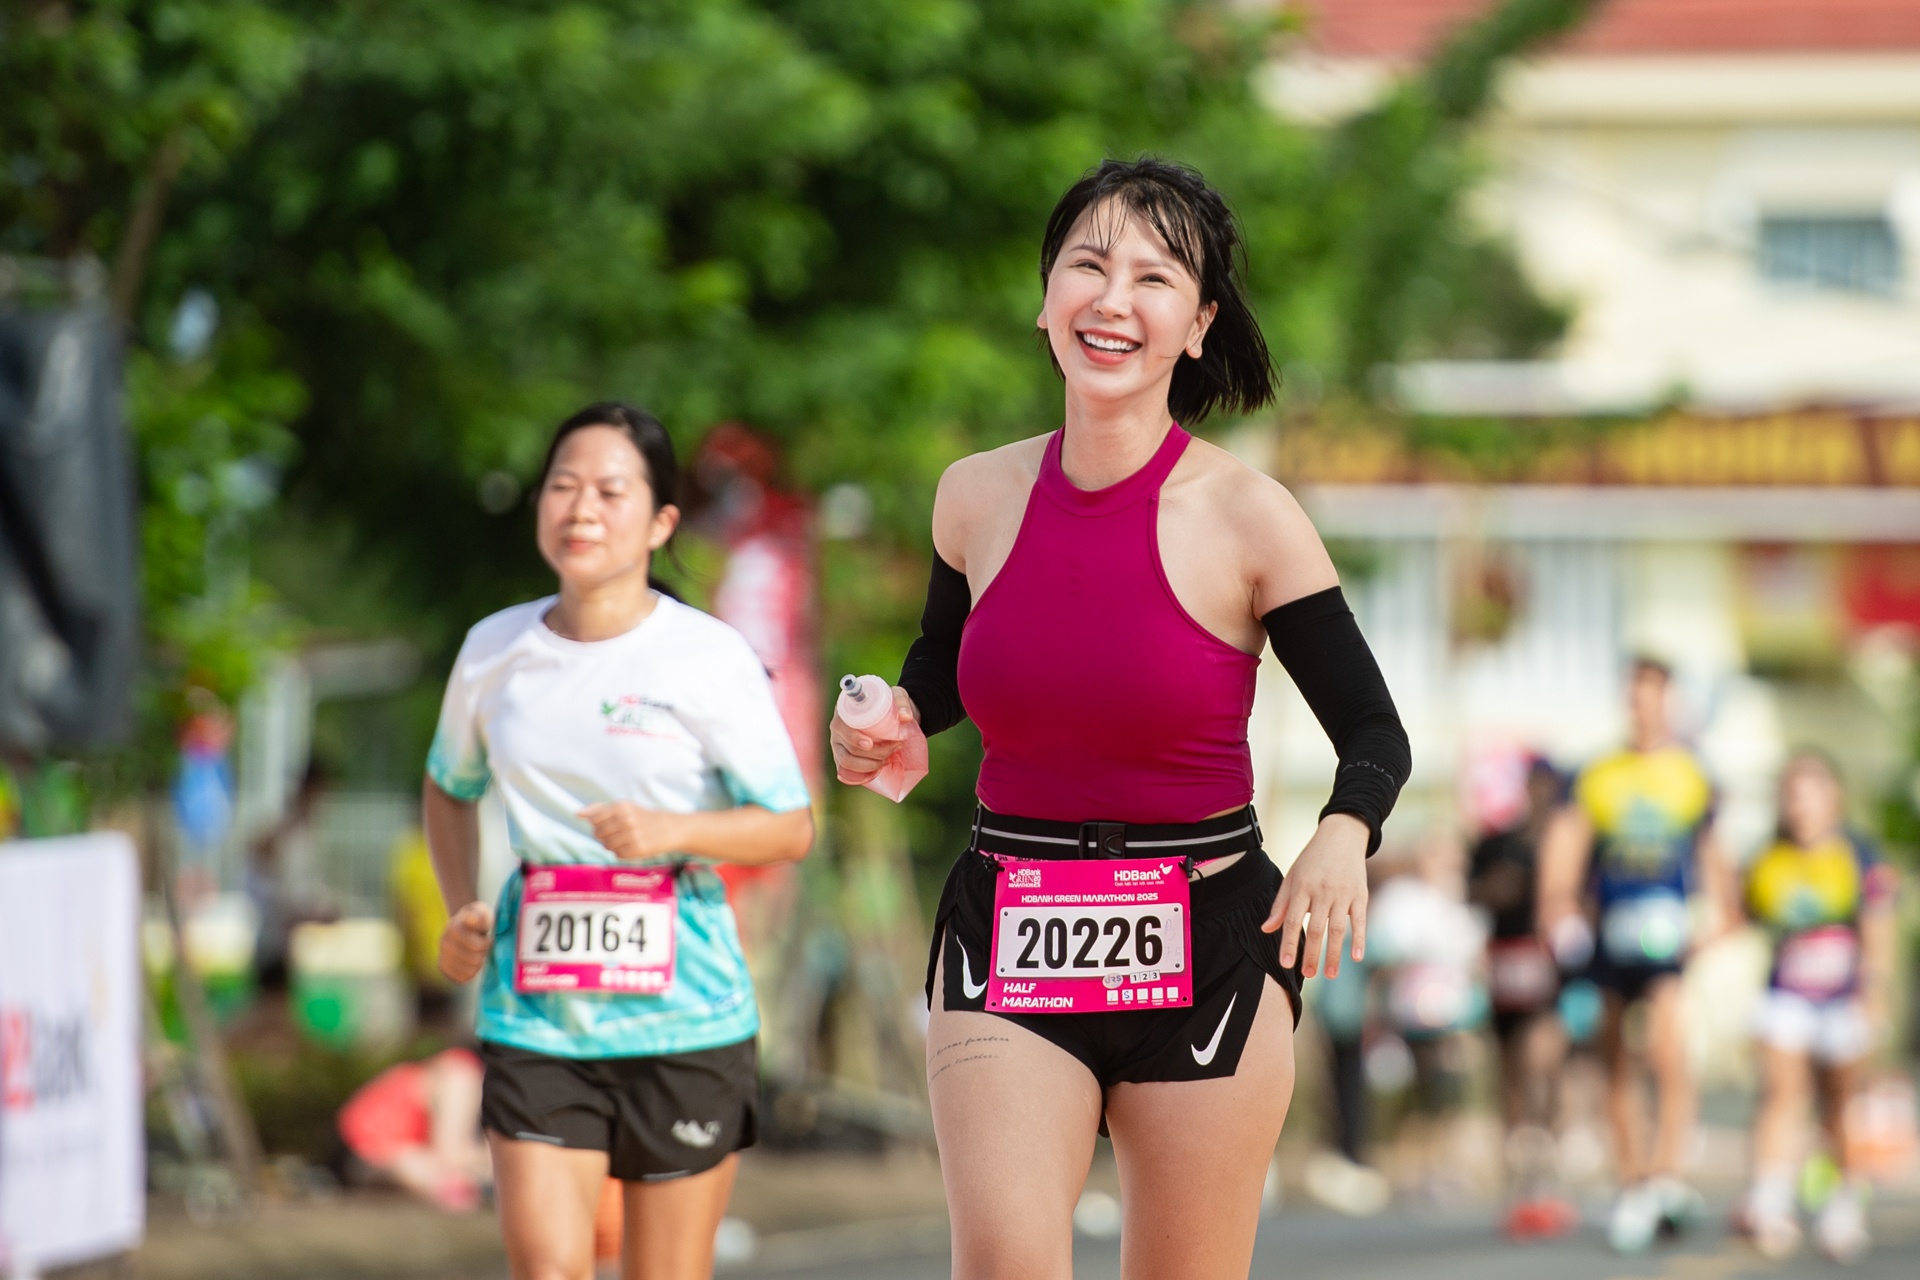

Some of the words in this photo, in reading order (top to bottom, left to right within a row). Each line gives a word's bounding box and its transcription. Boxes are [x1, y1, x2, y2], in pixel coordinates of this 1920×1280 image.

[1114, 869, 1161, 881] HDBank
[1021, 894, 1054, 903] HDBANK
[1055, 894, 1081, 903] GREEN
[1082, 893, 1135, 902] MARATHON
[1136, 892, 1158, 901] 2025
[535, 911, 647, 953] 20164
[1016, 915, 1163, 970] 20226
[1003, 982, 1037, 993] HALF
[1001, 996, 1074, 1008] MARATHON
